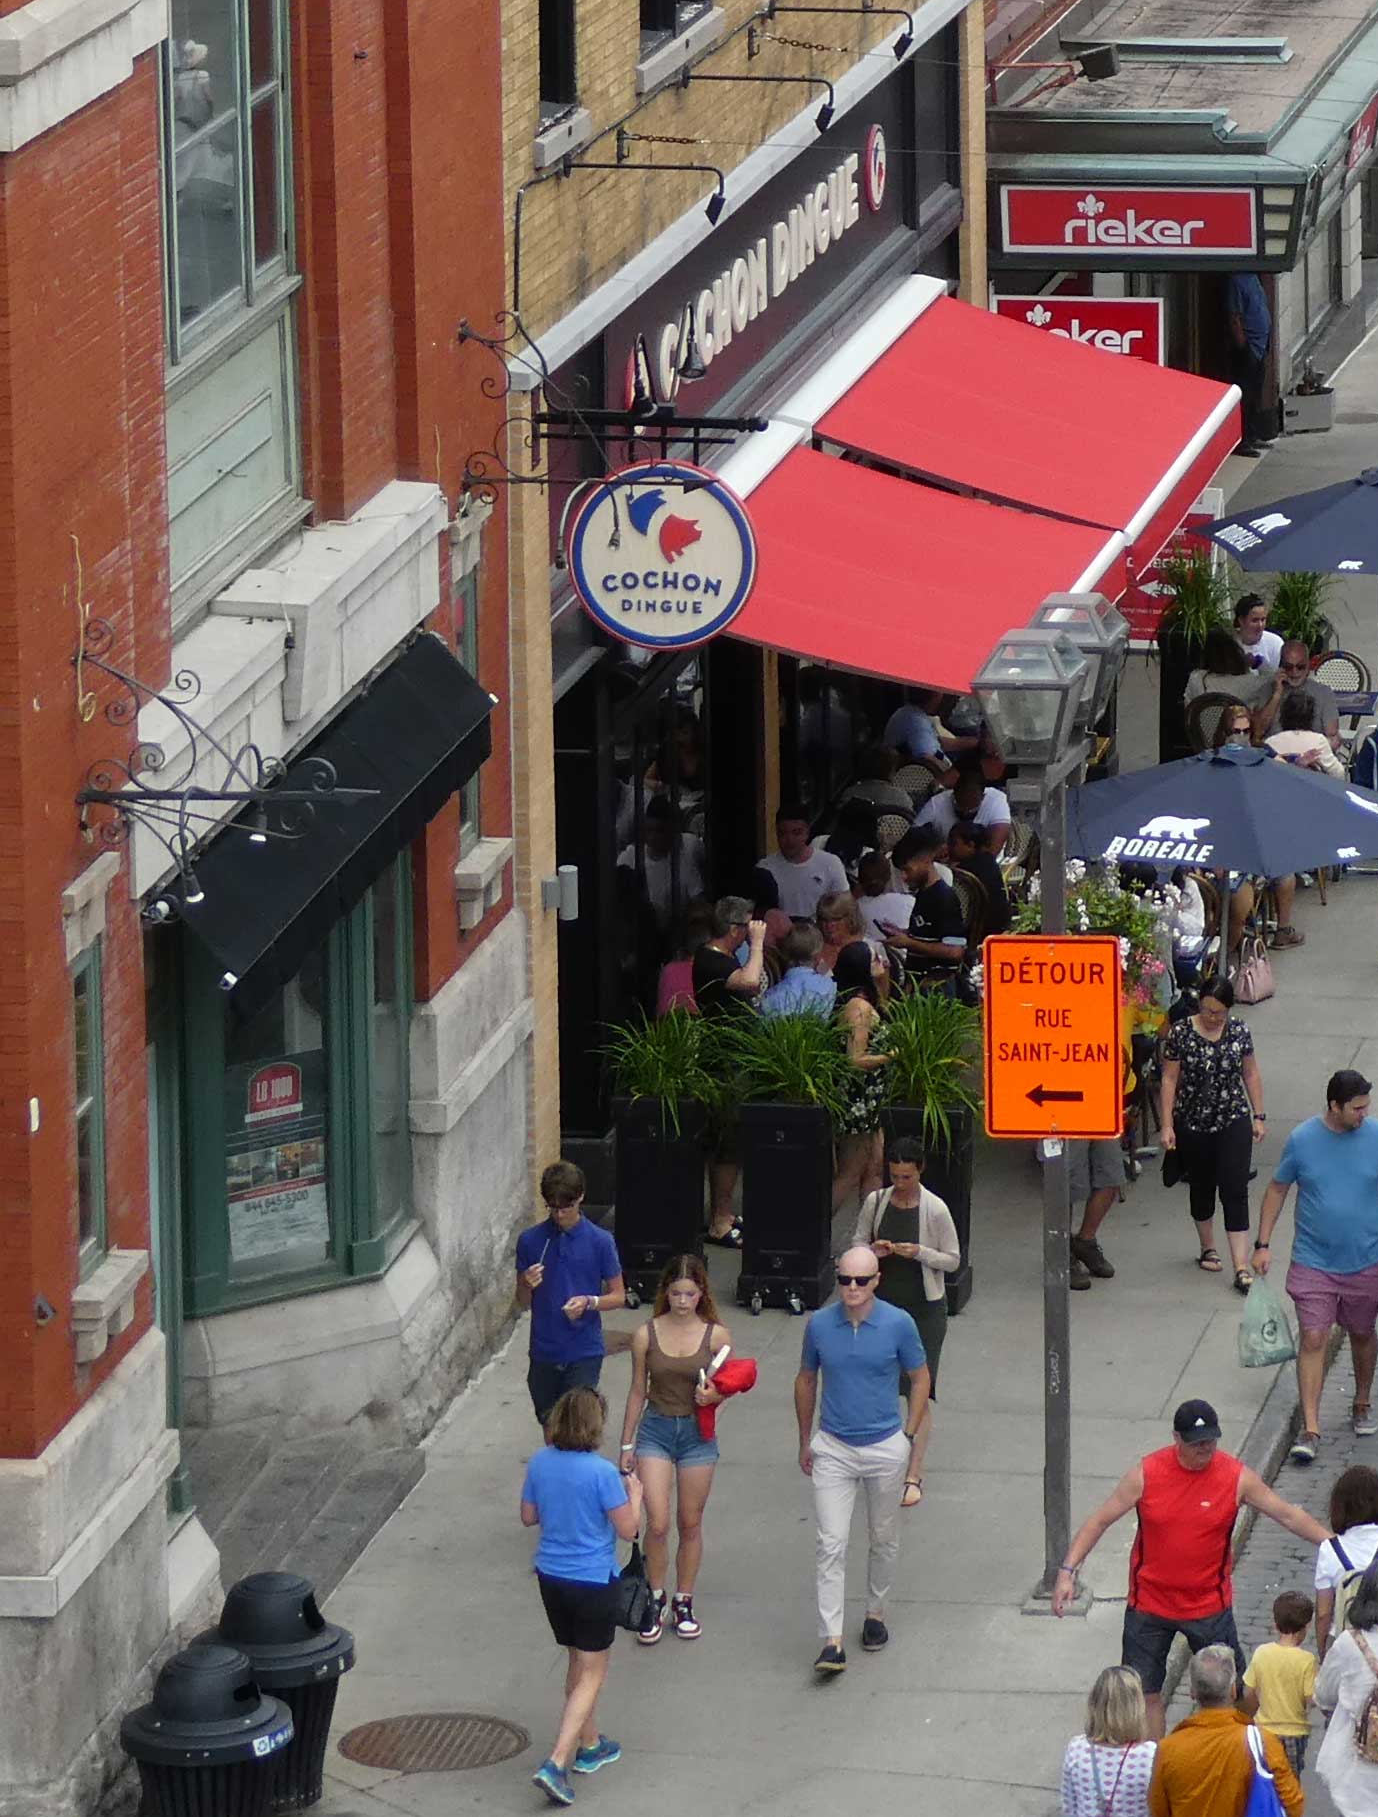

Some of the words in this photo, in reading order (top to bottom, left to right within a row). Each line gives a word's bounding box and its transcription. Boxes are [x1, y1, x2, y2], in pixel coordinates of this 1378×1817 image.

[772, 152, 860, 298] DINGUE
[1064, 209, 1204, 245] rieker
[602, 571, 722, 597] COCHON
[622, 599, 704, 615] DINGUE
[1000, 956, 1105, 985] DÉTOUR
[1035, 1008, 1073, 1028] RUE
[998, 1042, 1109, 1063] SAINT-JEAN
